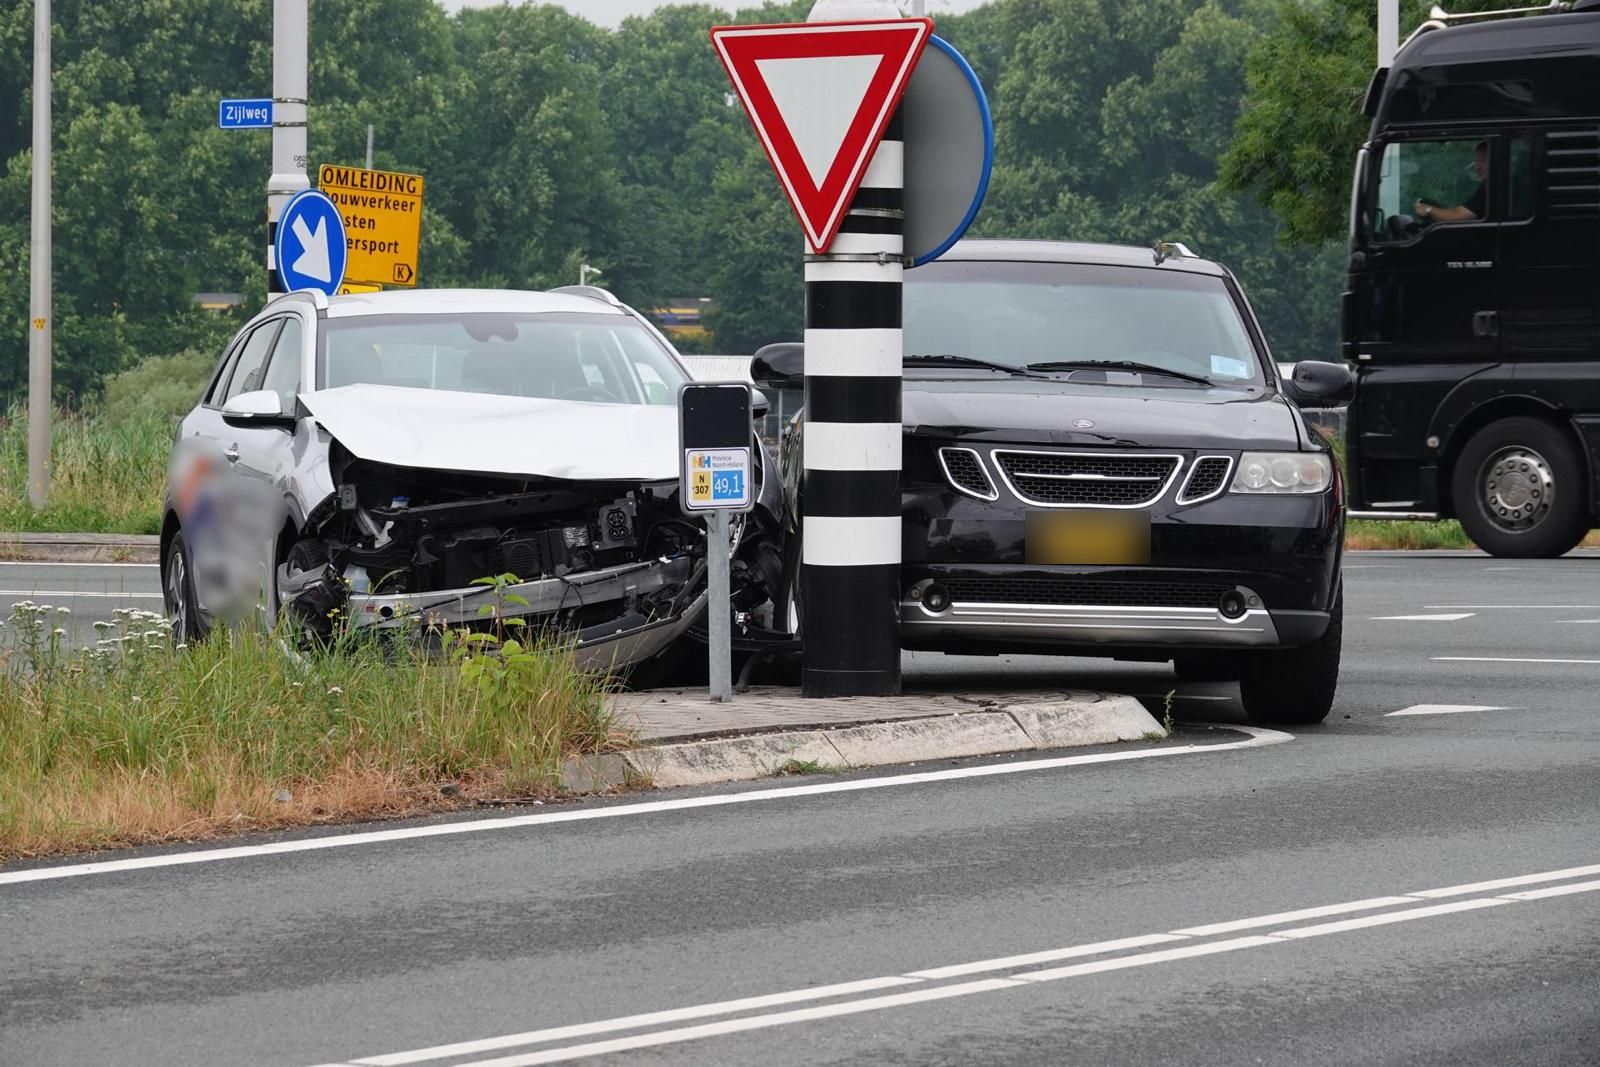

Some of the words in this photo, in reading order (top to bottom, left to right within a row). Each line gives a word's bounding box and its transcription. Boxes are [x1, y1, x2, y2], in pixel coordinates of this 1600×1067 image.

[226, 106, 268, 124] Zijlweg
[323, 168, 417, 194] OMLEIDING
[344, 214, 376, 231] sten
[346, 237, 400, 256] ersport
[397, 266, 405, 279] K
[699, 474, 705, 484] N
[714, 473, 741, 497] 49,1
[695, 485, 709, 495] 307
